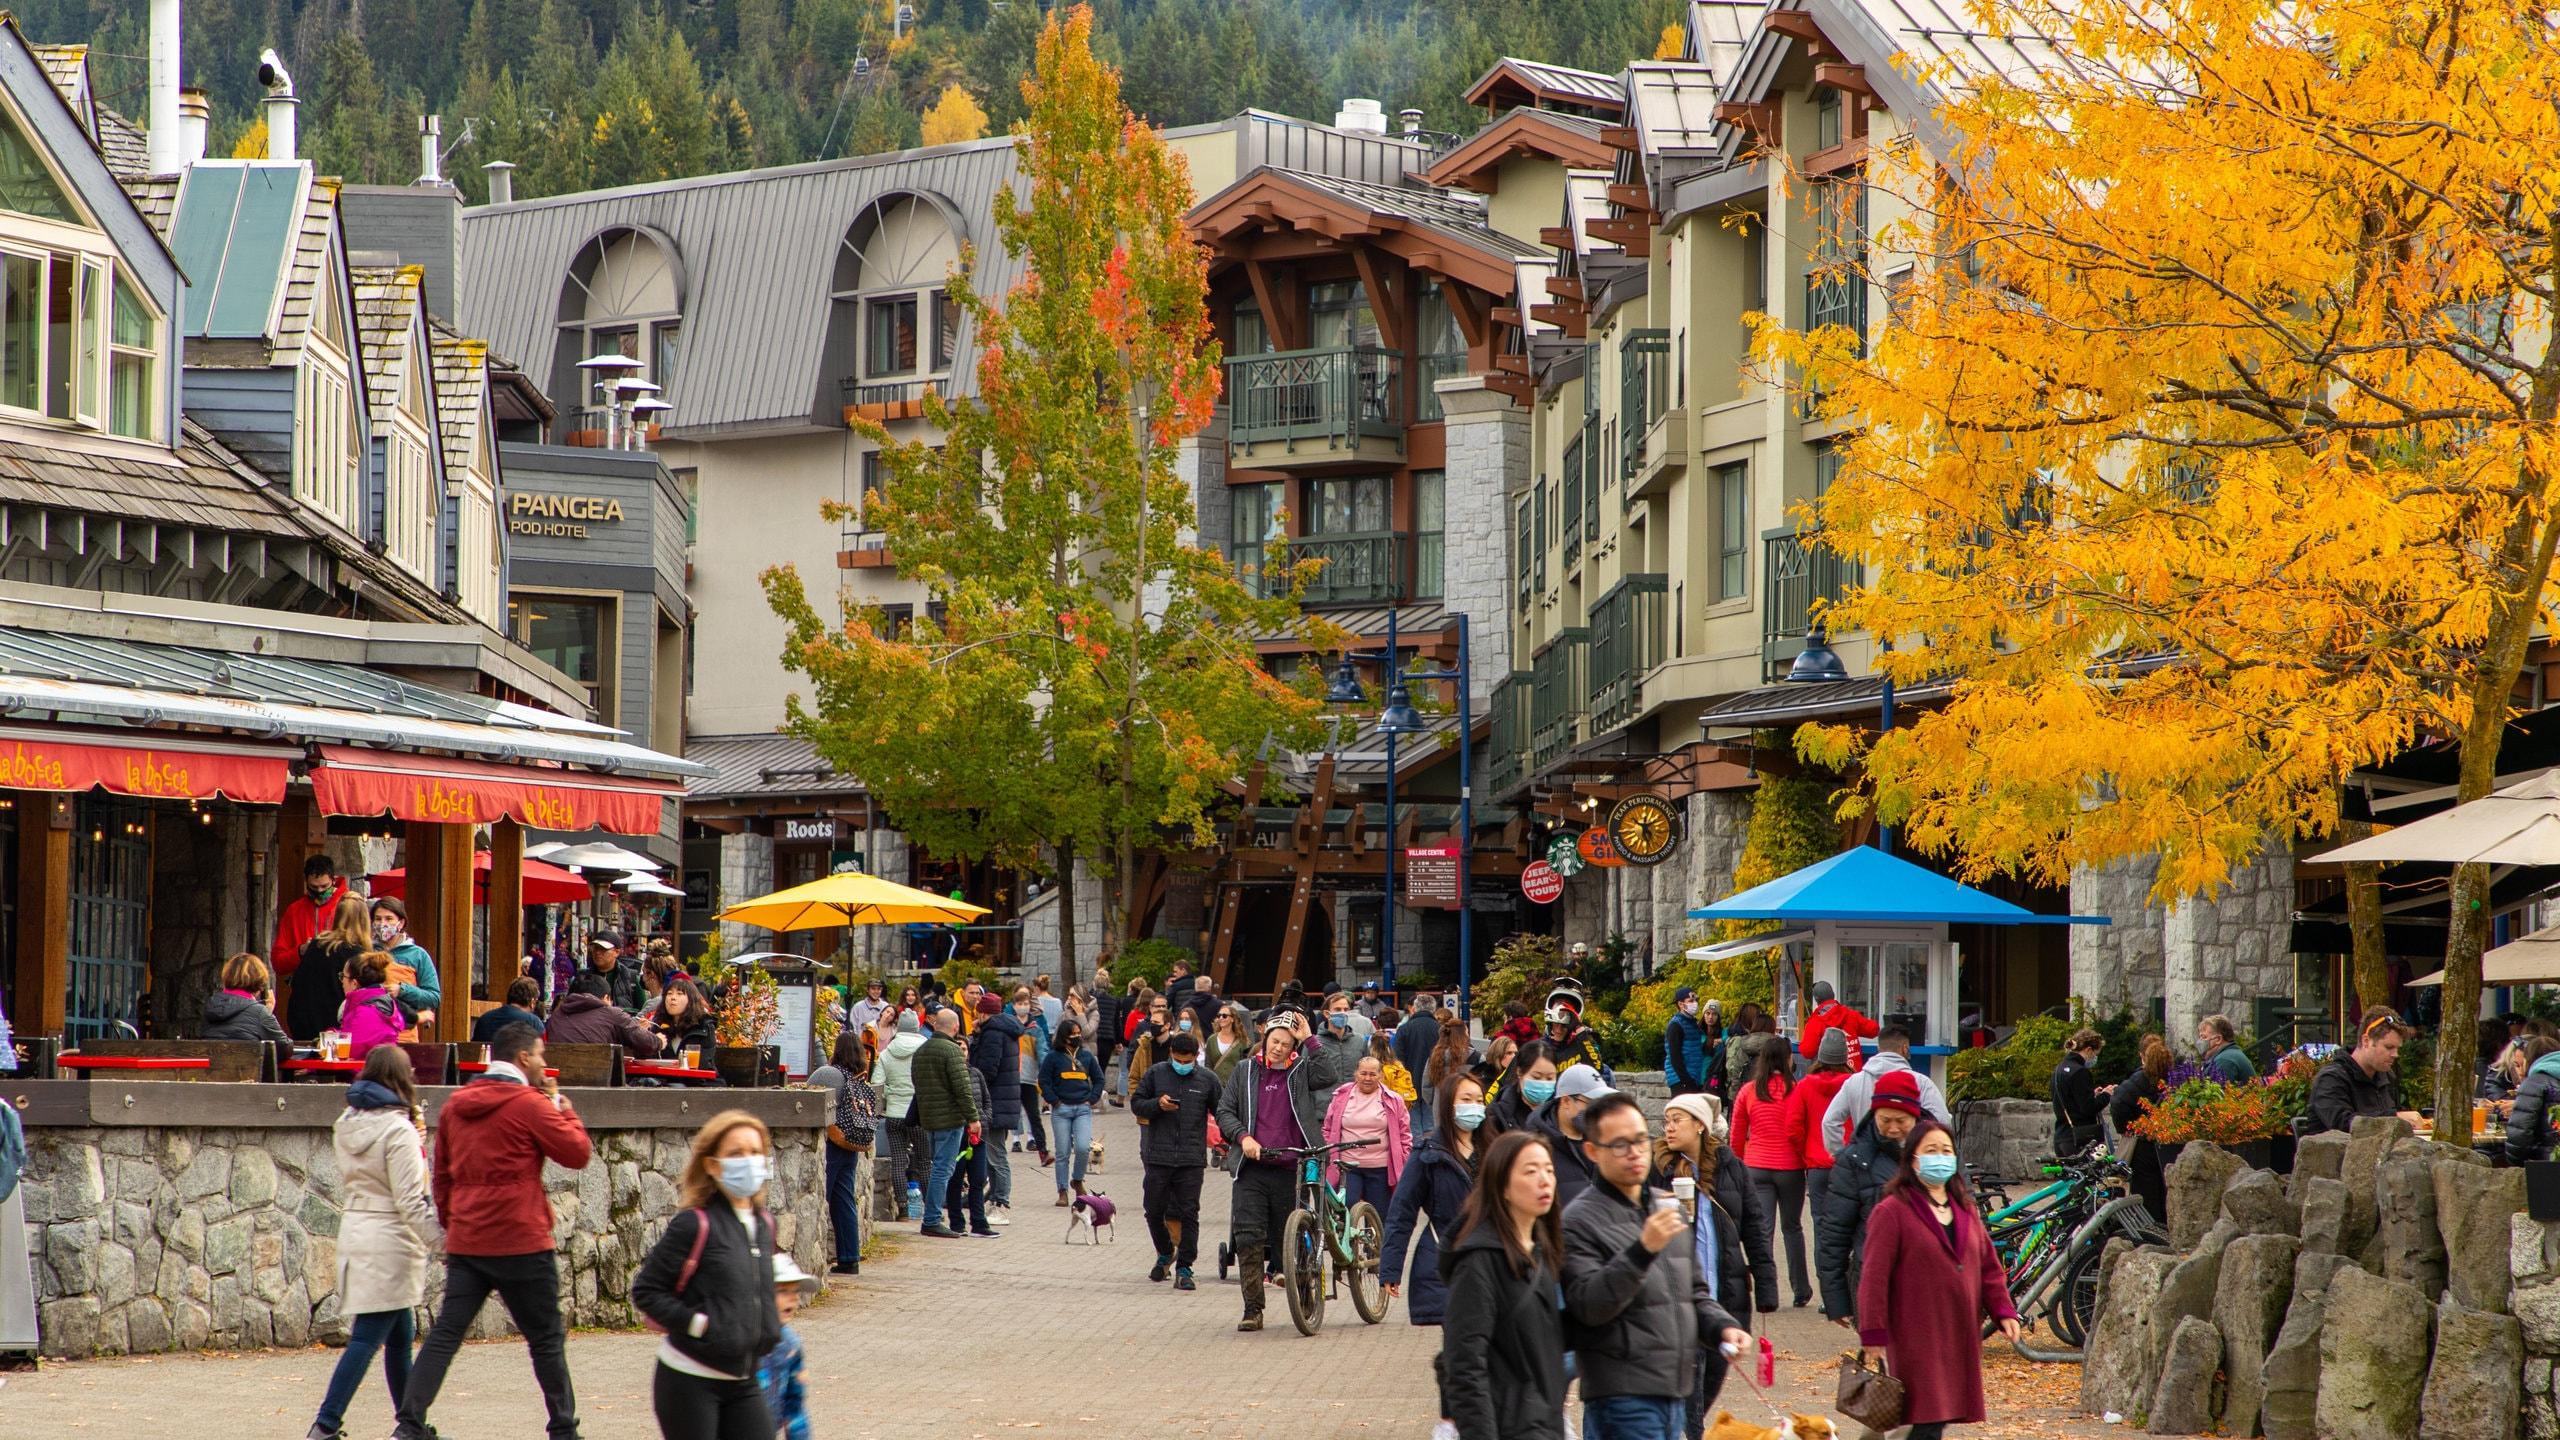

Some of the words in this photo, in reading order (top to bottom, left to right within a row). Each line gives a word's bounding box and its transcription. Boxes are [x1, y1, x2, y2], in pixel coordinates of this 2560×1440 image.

[513, 493, 625, 521] PANGEA
[511, 521, 542, 535] POD
[544, 523, 591, 538] HOTEL
[15, 742, 66, 788] bocca
[127, 756, 143, 792] la
[145, 752, 192, 796] bocca
[416, 783, 428, 818] la
[431, 780, 475, 819] bocca
[524, 794, 537, 826] la
[538, 789, 573, 830] bocca
[1614, 803, 1629, 820] PEAK
[1628, 797, 1676, 820] PERFORMANCE
[786, 820, 833, 838] Roots
[1632, 855, 1659, 863] MASSAGE
[1527, 866, 1551, 878] JEEP
[1524, 877, 1549, 888] BEAR
[1529, 884, 1560, 897] TOURS
